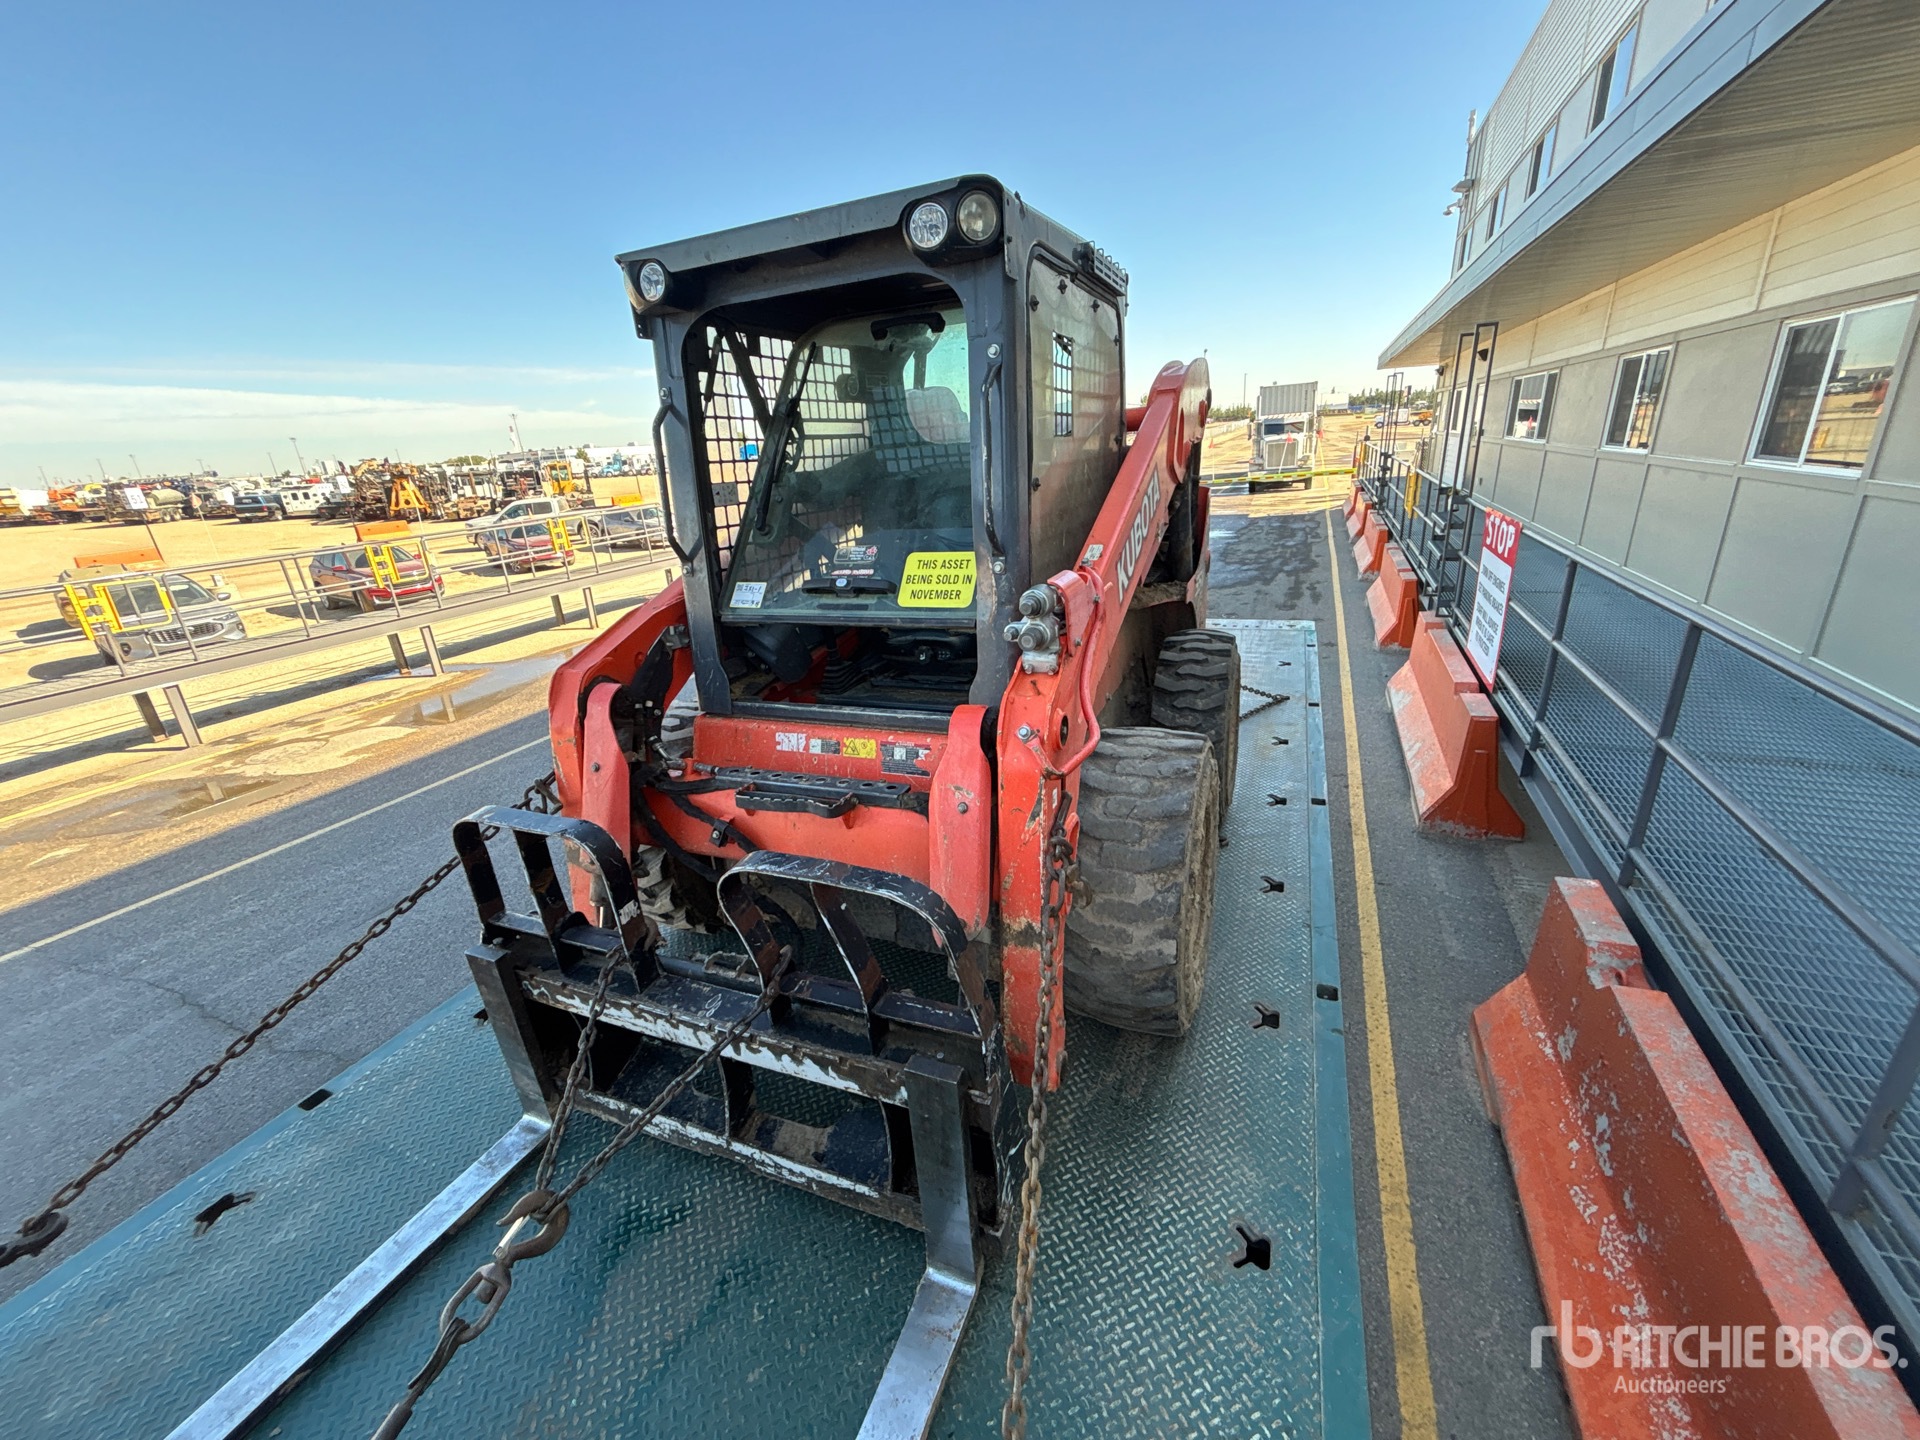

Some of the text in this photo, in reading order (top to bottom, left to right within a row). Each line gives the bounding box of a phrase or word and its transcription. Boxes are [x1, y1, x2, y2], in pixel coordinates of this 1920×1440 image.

[1117, 468, 1160, 603] KUBOTA
[1486, 514, 1516, 558] STOP
[917, 559, 972, 570] THIS ASSET
[905, 574, 973, 585] BEING SOLD IN
[909, 589, 962, 600] NOVEMBER
